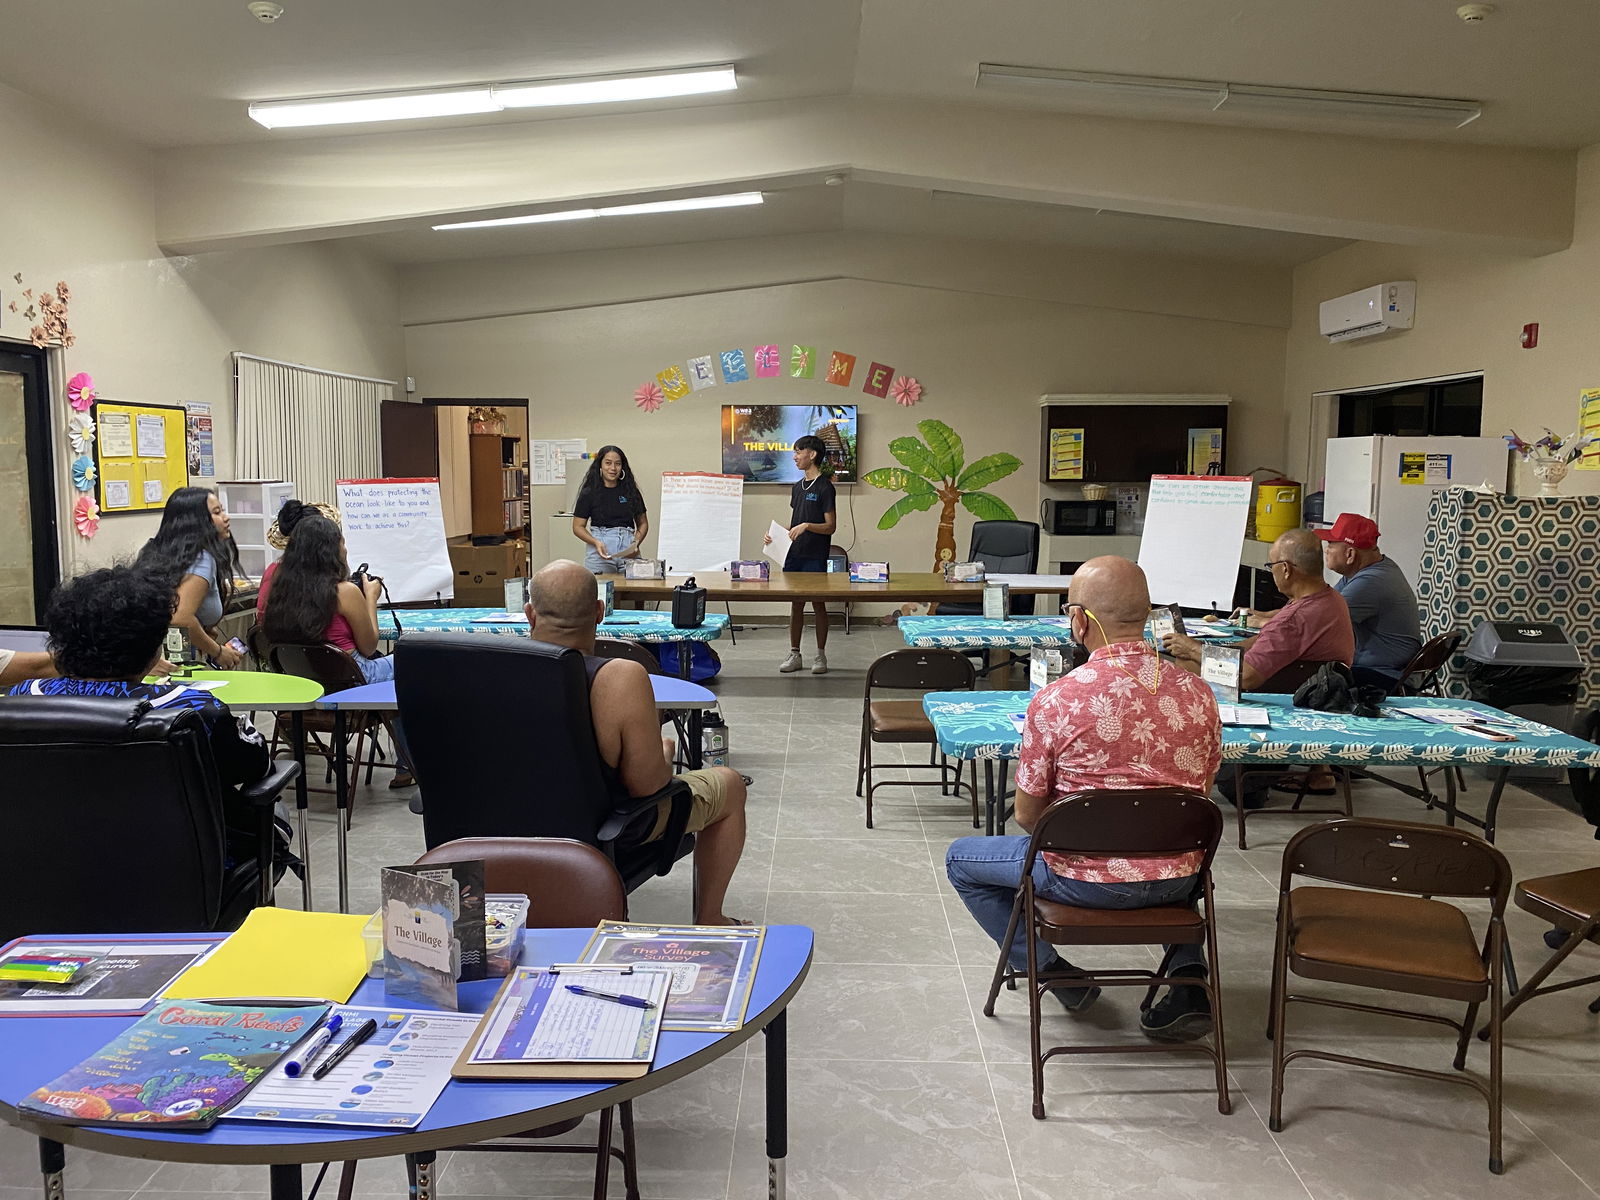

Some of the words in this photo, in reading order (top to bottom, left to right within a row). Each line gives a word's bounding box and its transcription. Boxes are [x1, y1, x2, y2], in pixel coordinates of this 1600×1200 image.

[743, 442, 765, 451] THE
[343, 488, 363, 497] What
[369, 488, 384, 497] does
[388, 488, 418, 498] protecting
[421, 487, 431, 496] the
[367, 500, 380, 508] look
[384, 499, 396, 507] like
[399, 499, 405, 507] to
[347, 511, 358, 519] how
[1217, 669, 1234, 678] Village
[394, 925, 411, 939] The
[413, 929, 442, 949] Village
[631, 947, 659, 955] The
[662, 947, 711, 957] Village
[643, 954, 694, 962] Survey
[158, 1006, 236, 1027] Coral
[233, 1012, 305, 1034] Reefs
